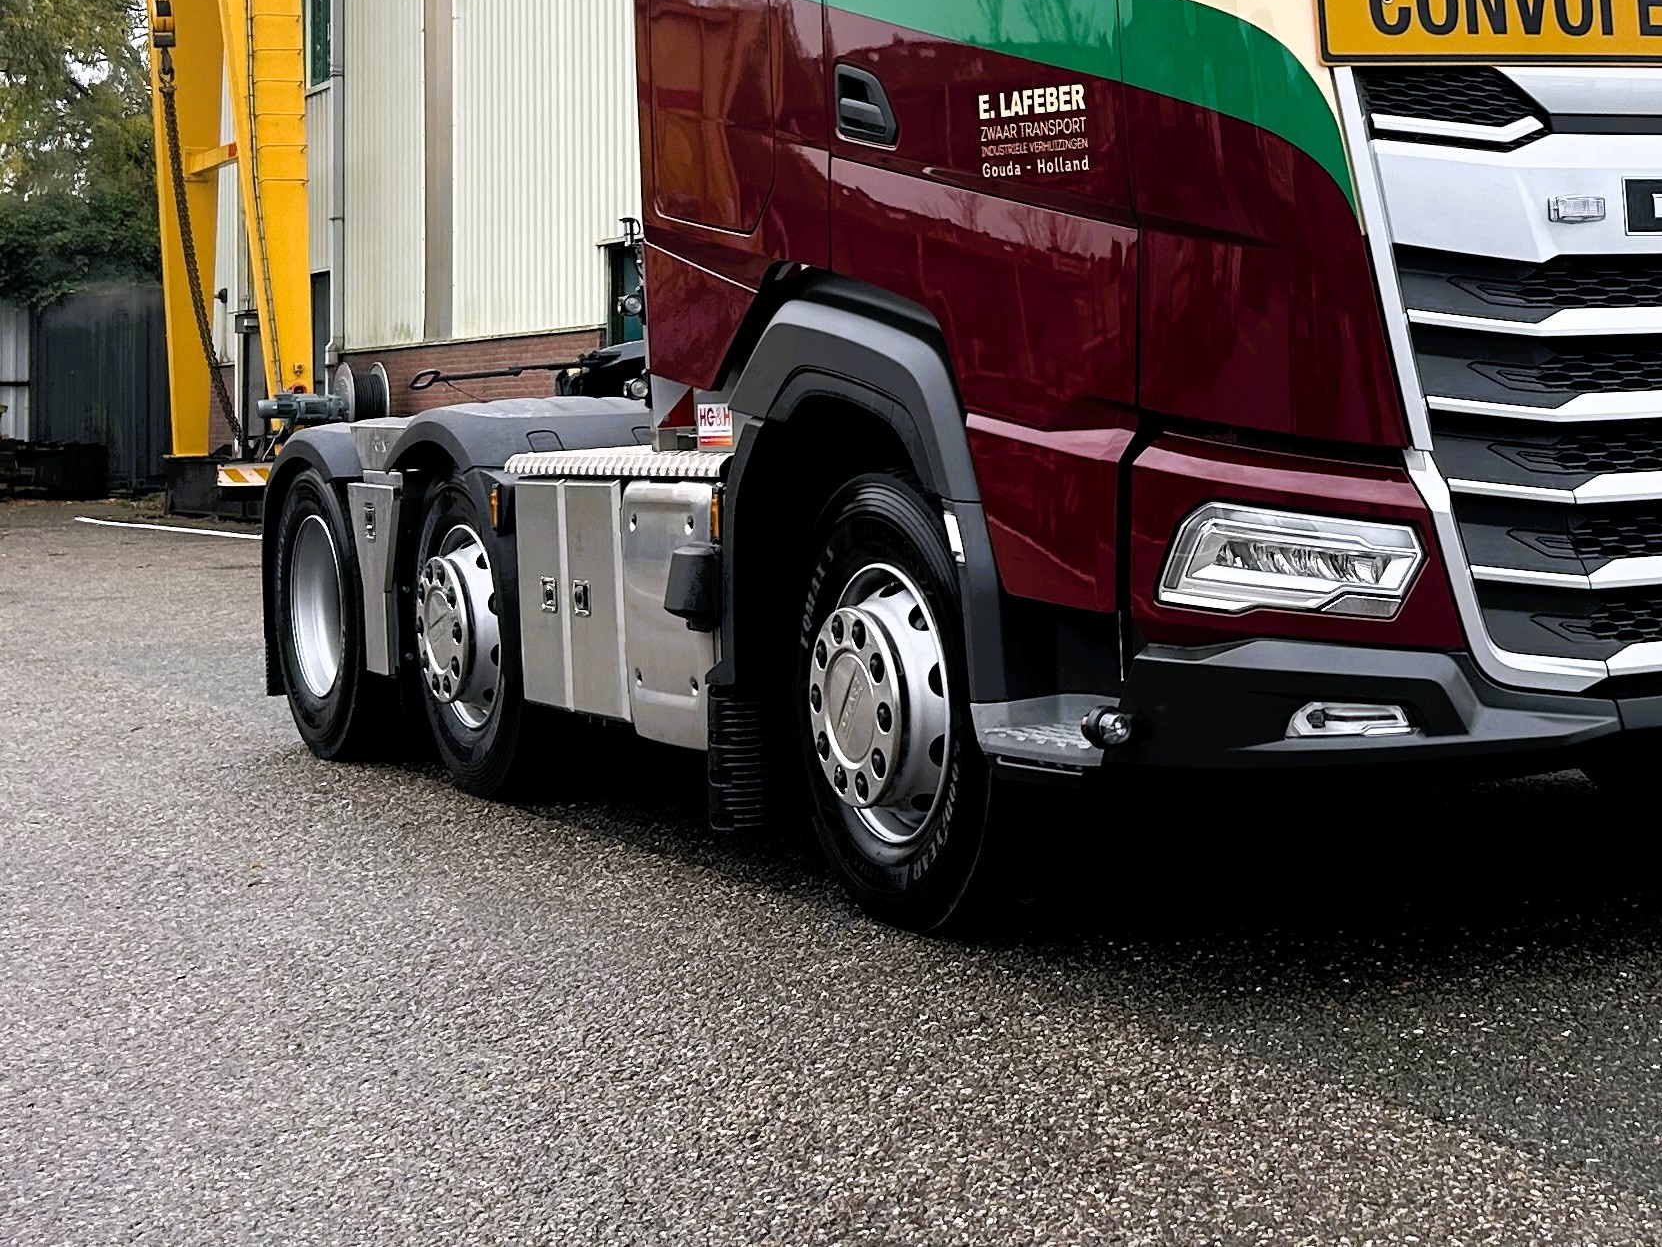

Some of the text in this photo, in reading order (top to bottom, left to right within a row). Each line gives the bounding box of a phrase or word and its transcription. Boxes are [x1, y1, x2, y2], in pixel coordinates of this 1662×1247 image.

[978, 84, 1086, 119] E. LAFEBER
[980, 117, 1087, 142] ZWAAR TRANSPORT
[982, 161, 1022, 178] Gouda
[1037, 155, 1090, 174] Holland
